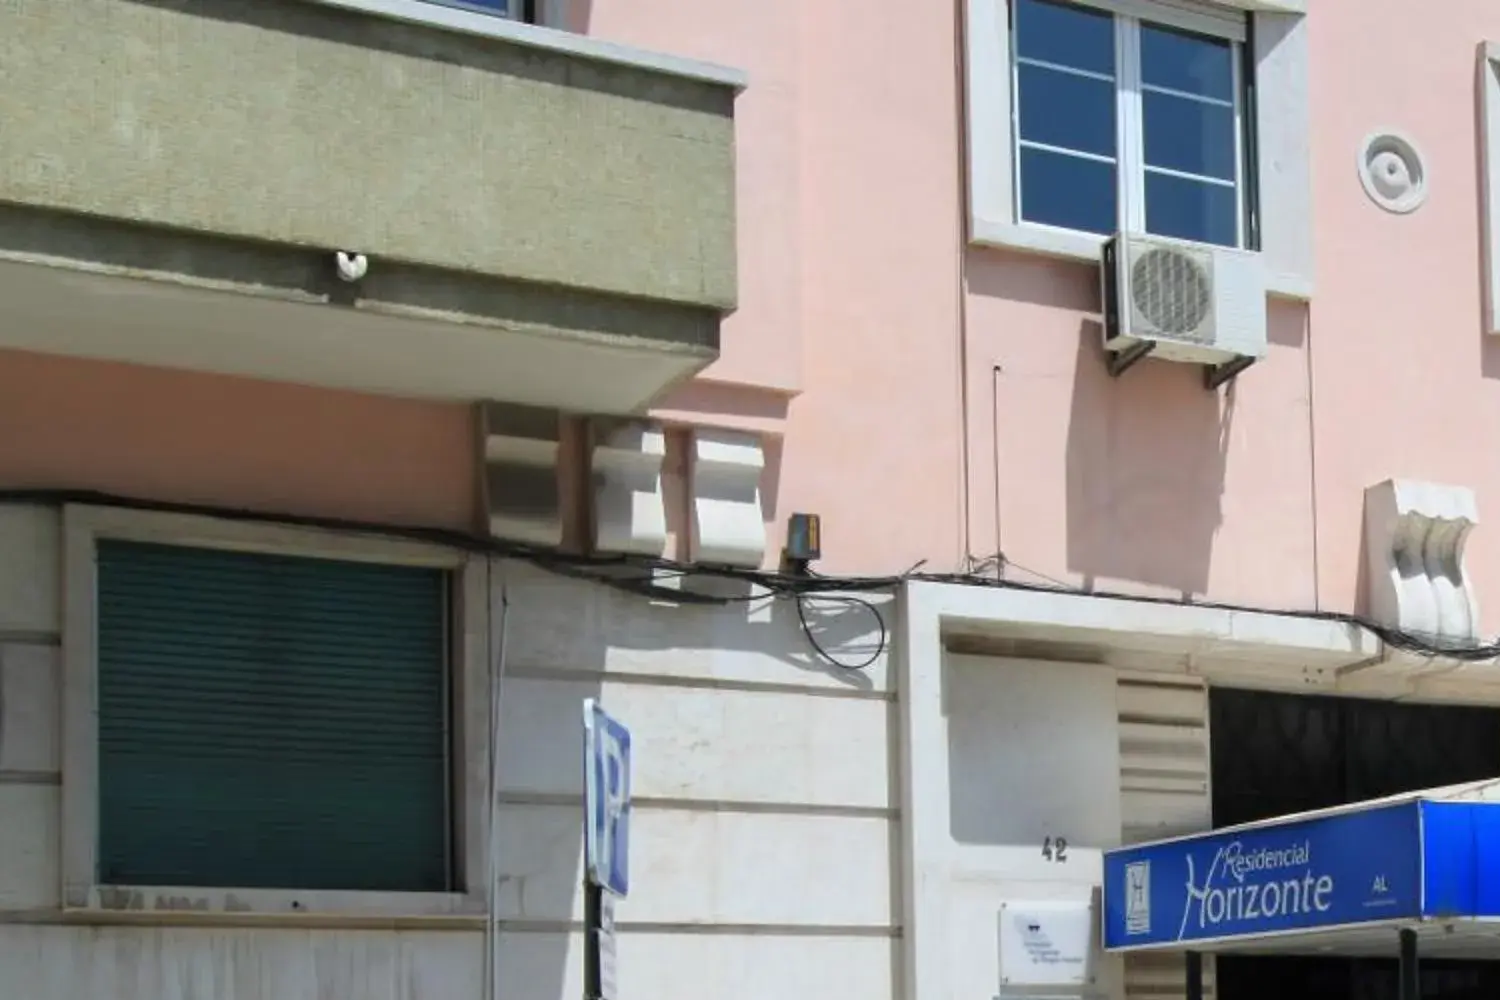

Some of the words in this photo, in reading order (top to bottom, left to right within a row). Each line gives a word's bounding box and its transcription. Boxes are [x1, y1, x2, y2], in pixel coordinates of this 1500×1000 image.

[602, 728, 624, 874] P
[1041, 835, 1067, 862] 42
[1220, 839, 1309, 883] Residencial
[1177, 847, 1333, 941] Horizonte
[1372, 874, 1389, 892] AL
